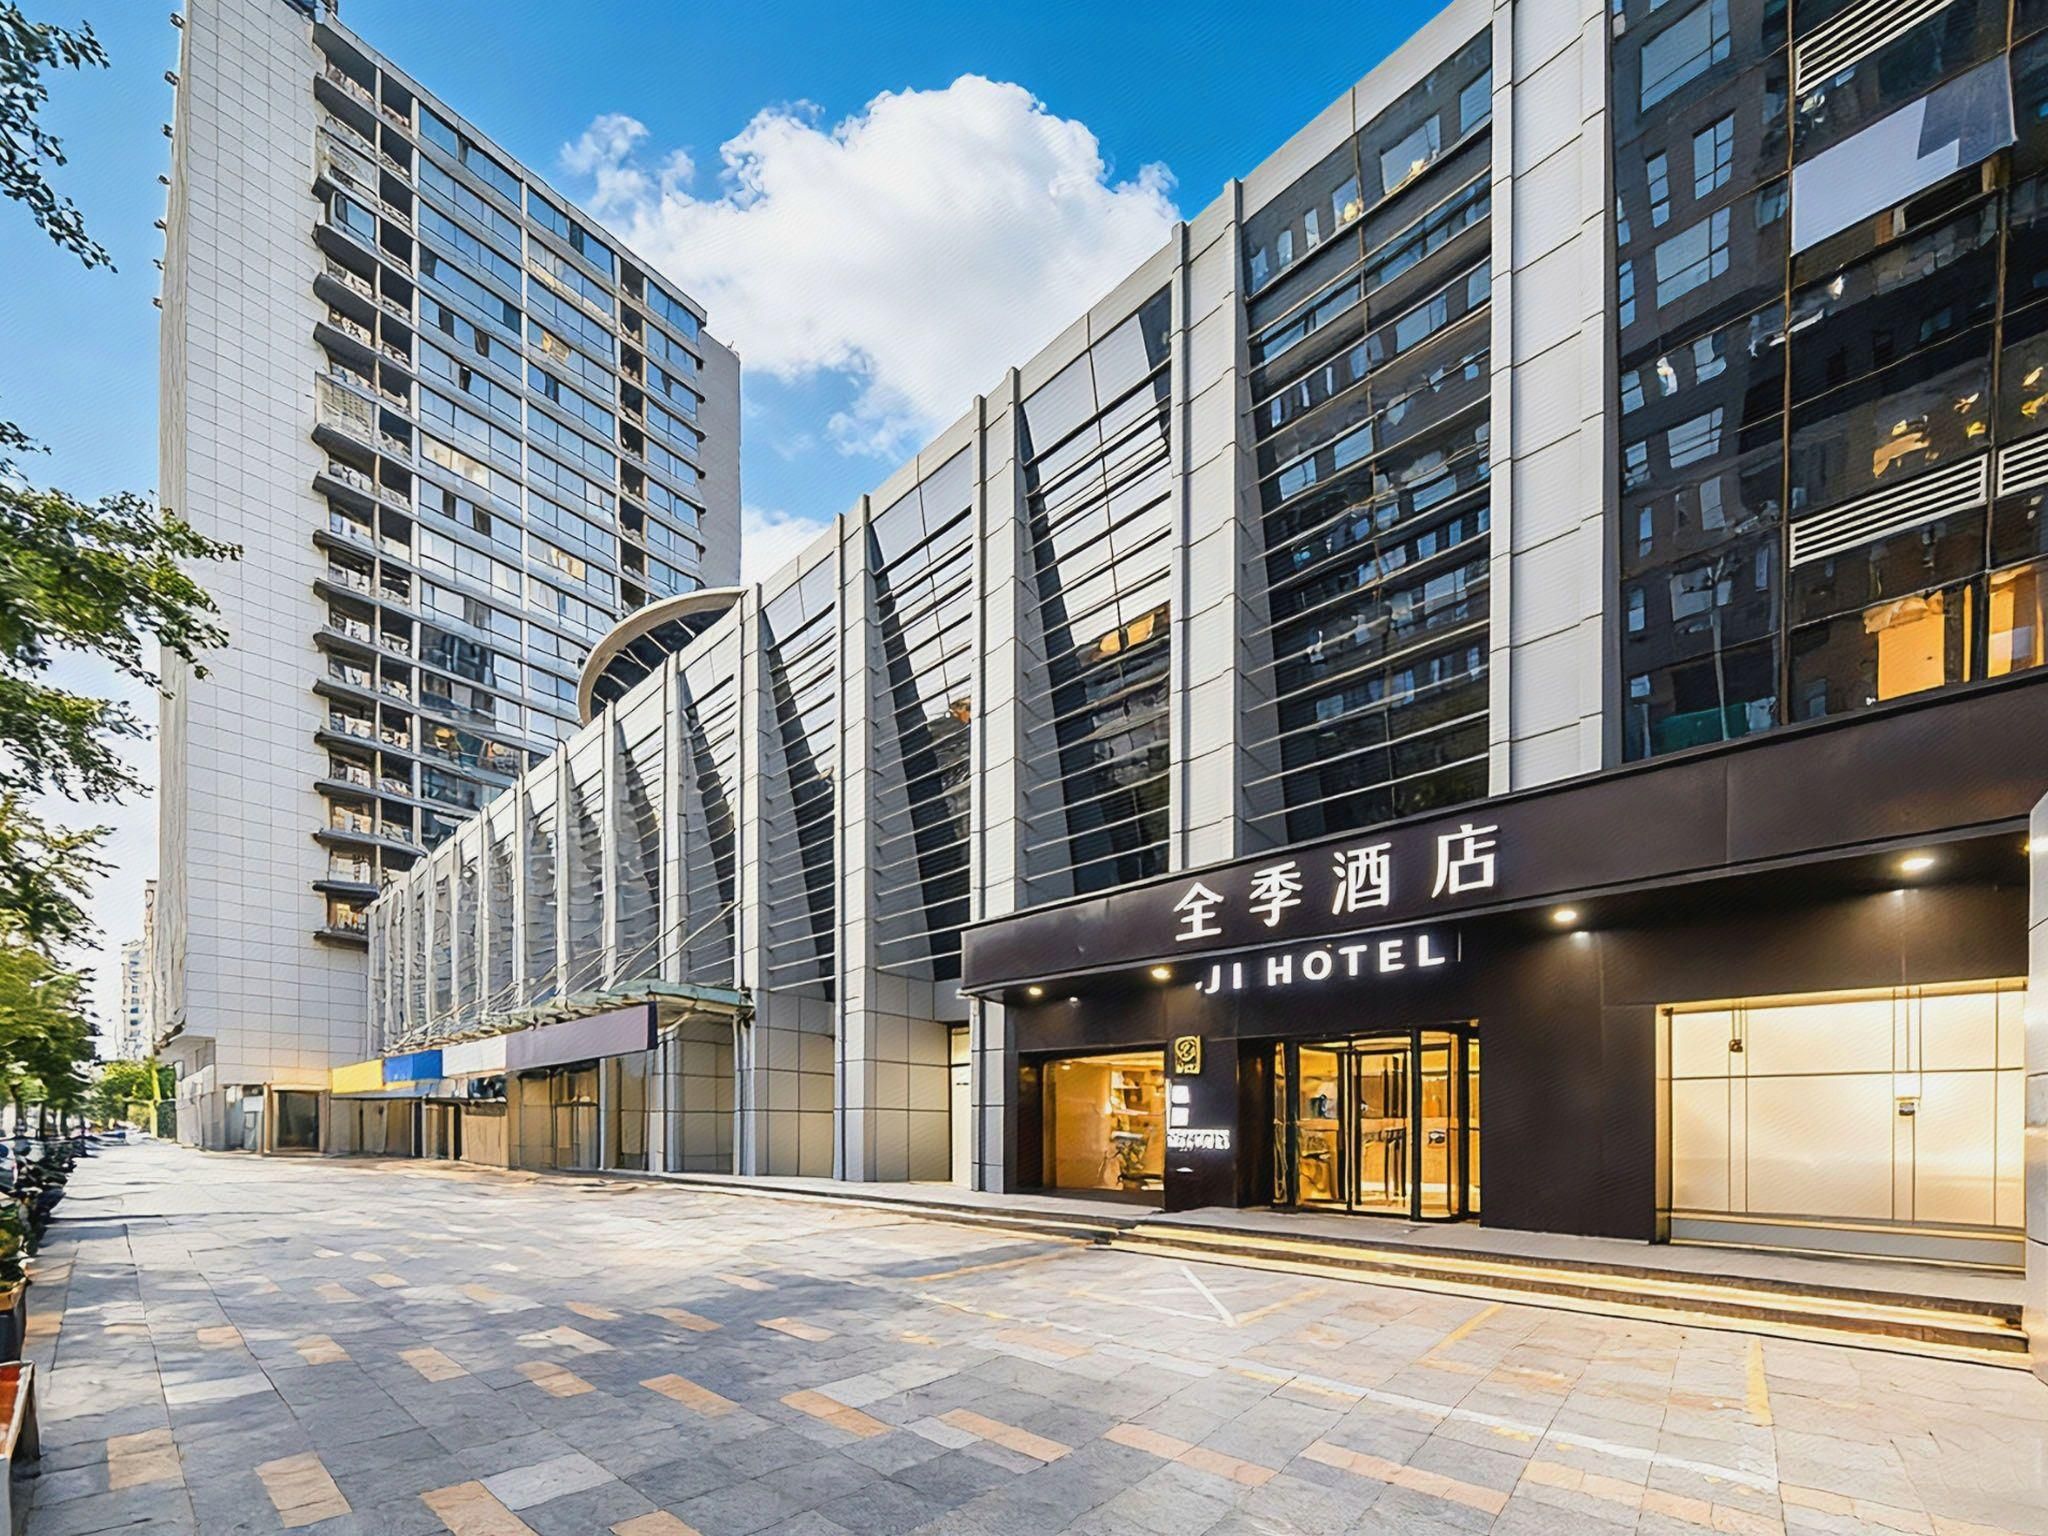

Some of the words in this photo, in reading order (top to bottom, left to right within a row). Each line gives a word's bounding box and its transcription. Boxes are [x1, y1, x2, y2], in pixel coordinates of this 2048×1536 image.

[1173, 823, 1498, 941] 全季酒店
[1197, 961, 1243, 994] JI
[1267, 934, 1446, 986] HOTEL
